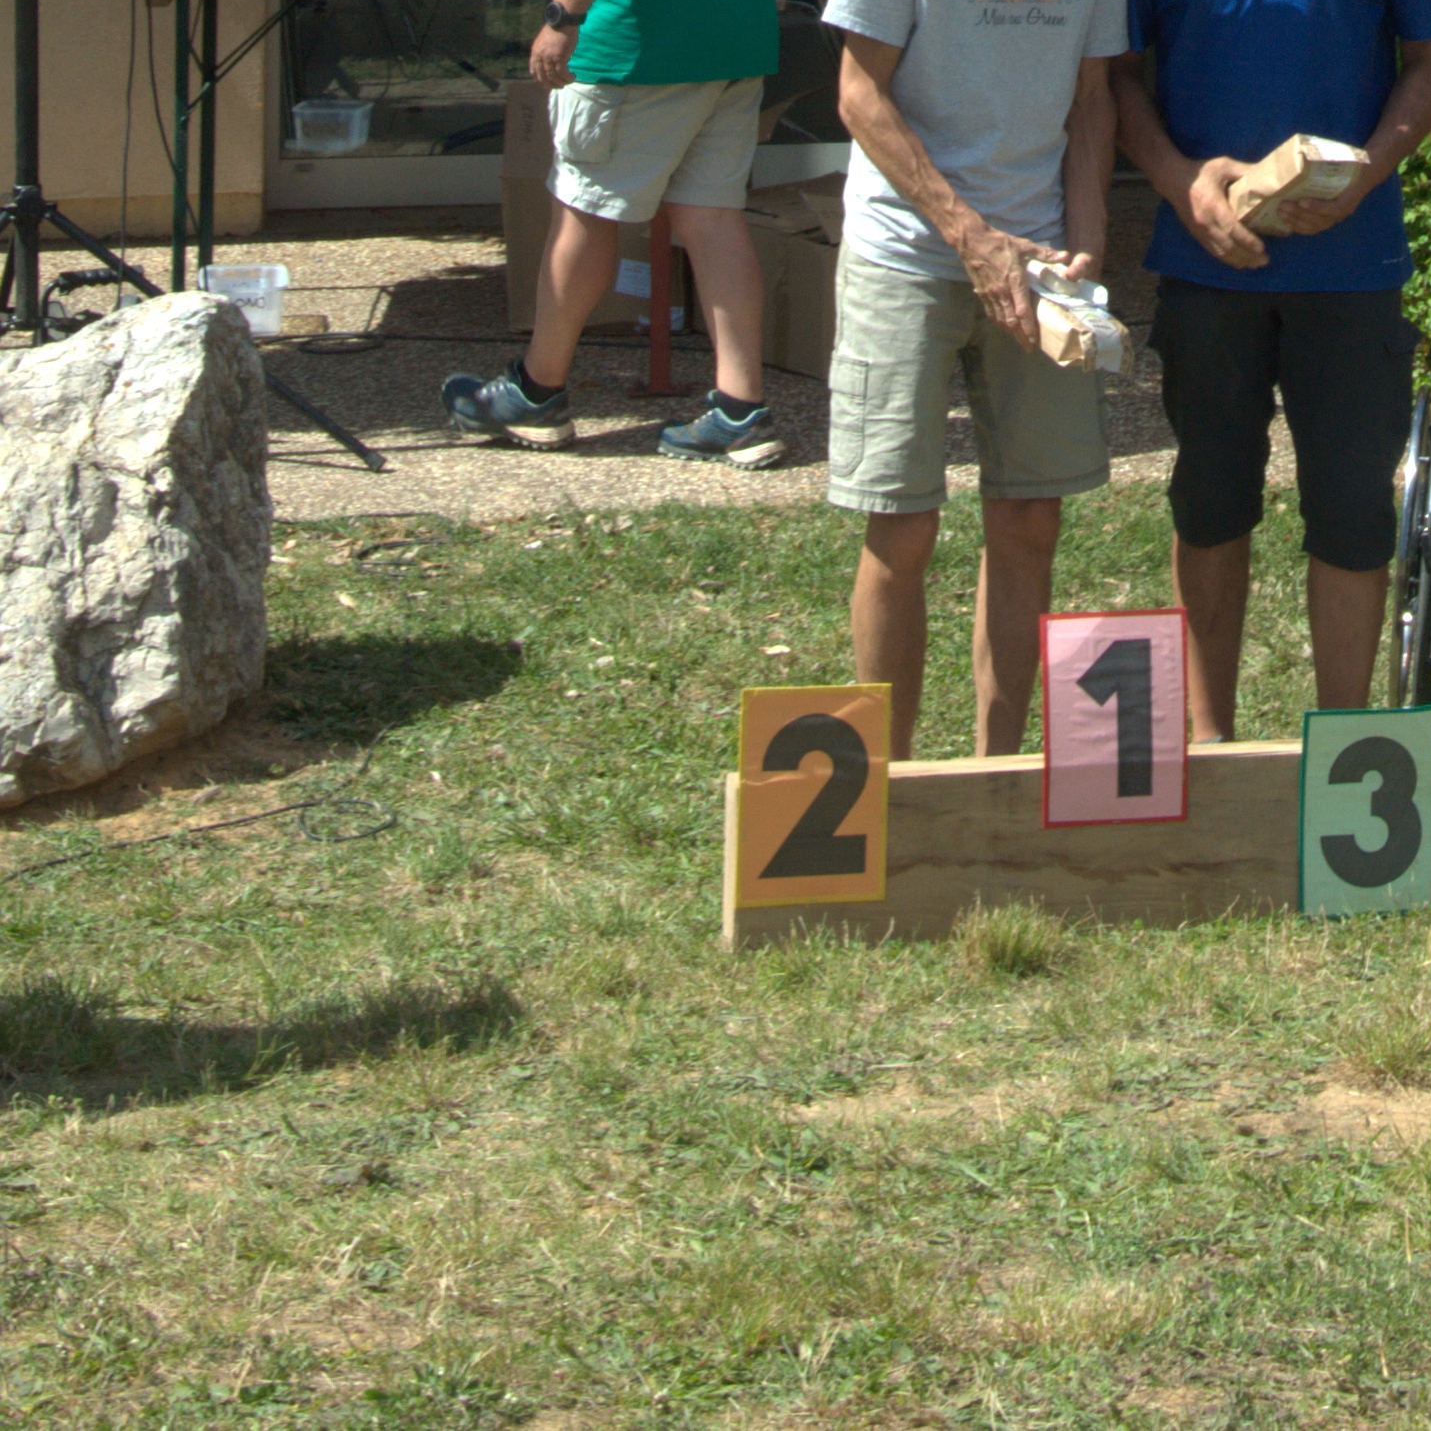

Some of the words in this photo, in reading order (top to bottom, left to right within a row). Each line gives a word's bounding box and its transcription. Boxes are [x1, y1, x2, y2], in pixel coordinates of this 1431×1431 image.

[758, 713, 870, 880] 2
[1076, 638, 1154, 798] 1
[1320, 736, 1423, 889] 3
